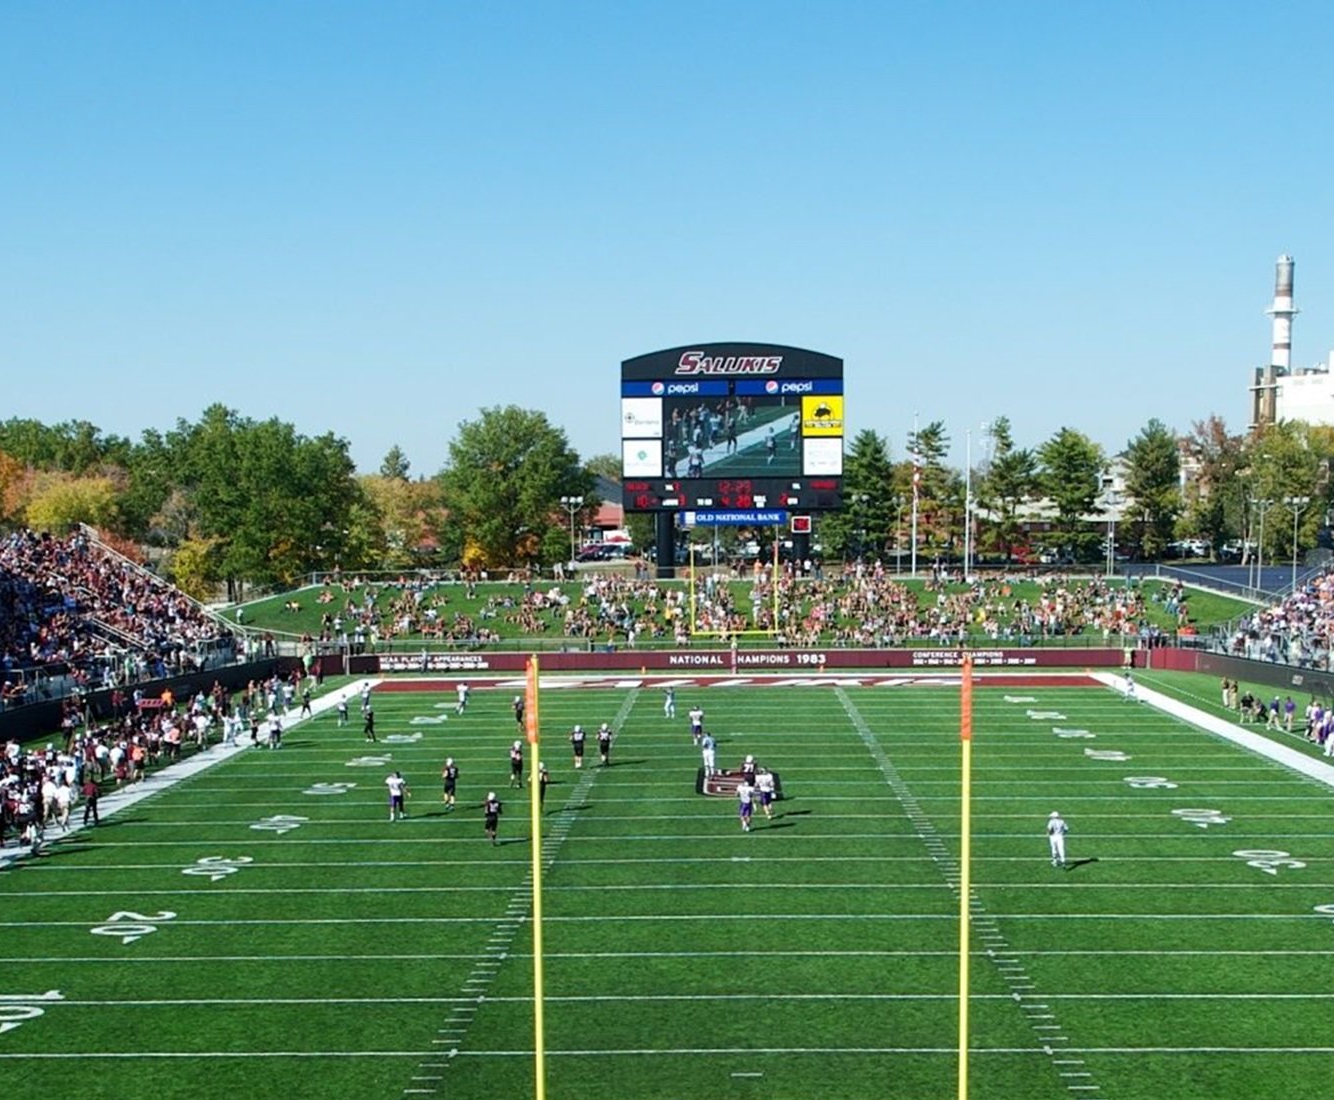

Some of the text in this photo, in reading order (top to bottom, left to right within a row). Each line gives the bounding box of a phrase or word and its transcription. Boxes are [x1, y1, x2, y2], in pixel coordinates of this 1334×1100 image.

[675, 351, 783, 375] SALUKIS
[668, 382, 699, 394] pepsi
[781, 381, 813, 393] pepsi
[696, 513, 780, 521] OLD NATIONAL BANK
[670, 654, 826, 664] NATIONAL HAMPIONS 1983
[181, 856, 253, 875] 30
[90, 911, 177, 936] 20
